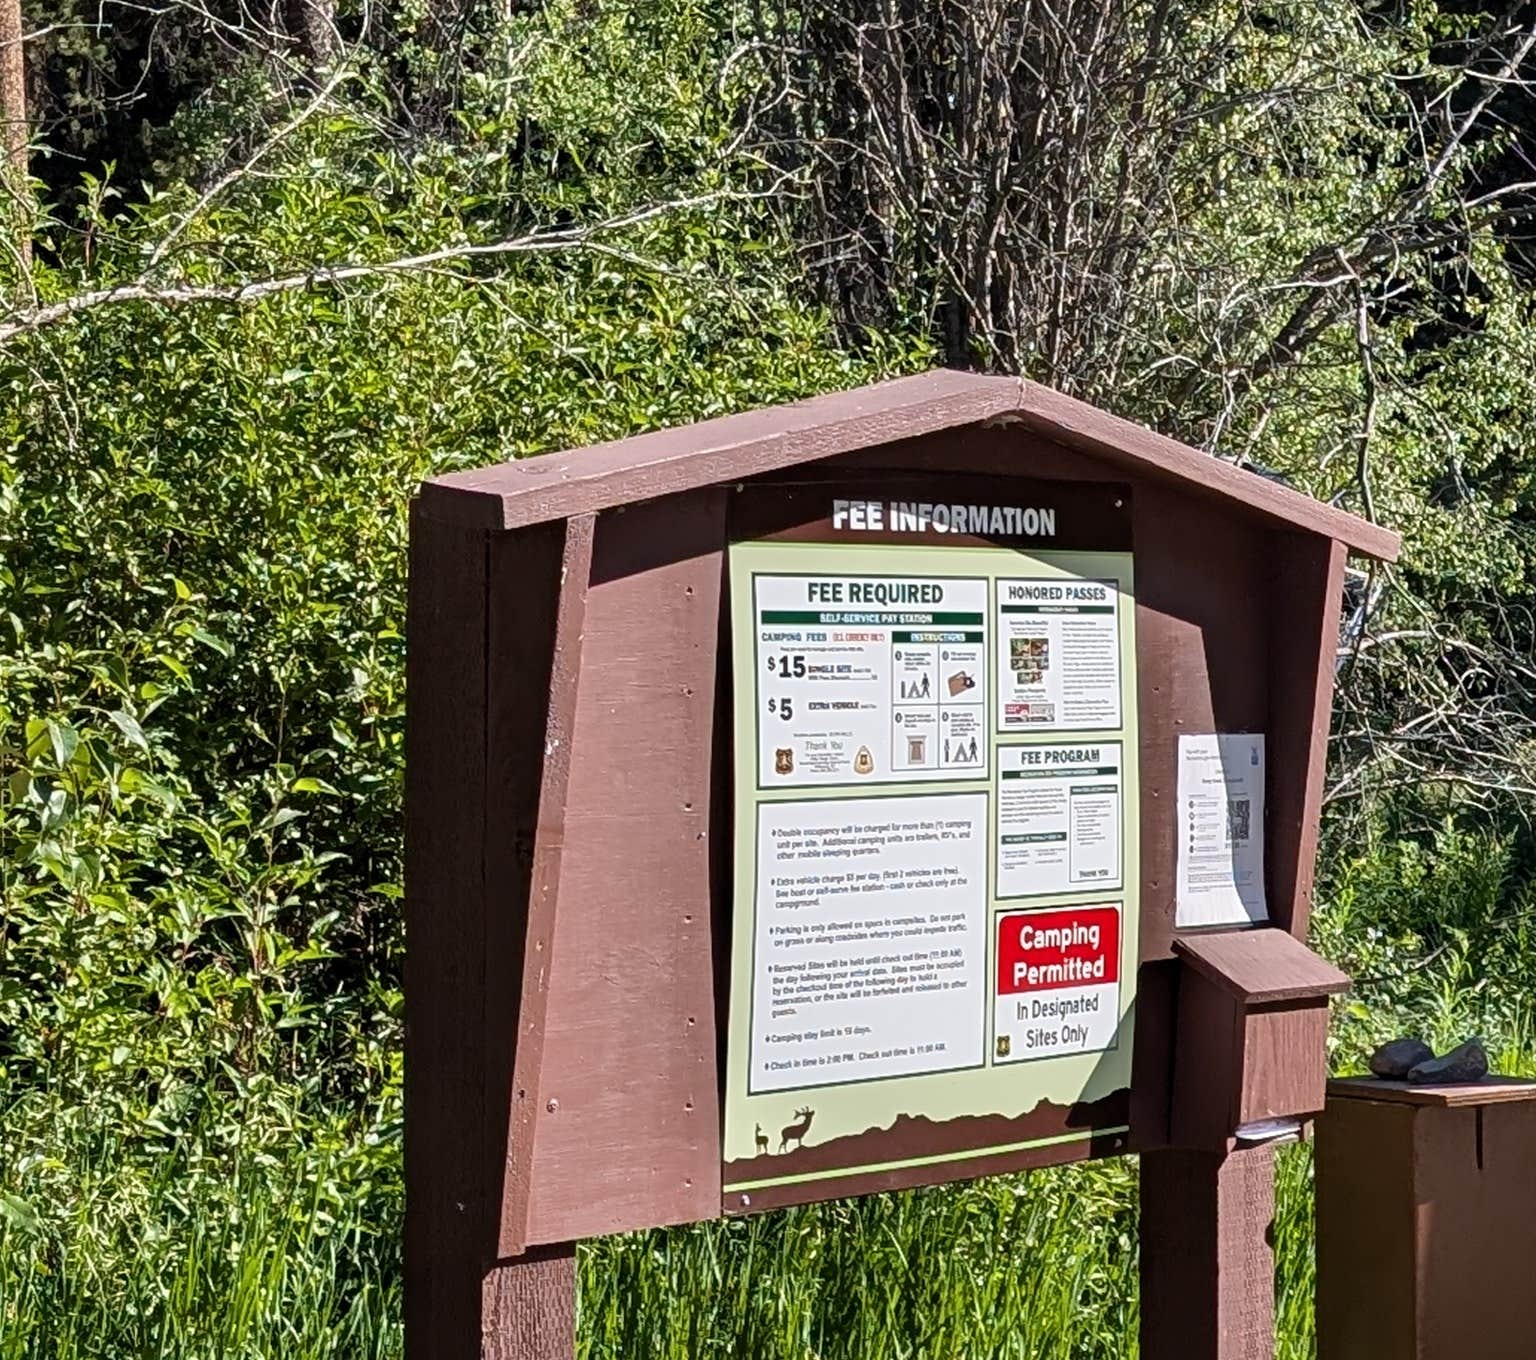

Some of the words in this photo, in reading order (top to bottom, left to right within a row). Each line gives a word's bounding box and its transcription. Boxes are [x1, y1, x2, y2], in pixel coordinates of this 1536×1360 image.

[833, 499, 883, 530] FEE
[890, 501, 1056, 536] INFORMATION
[808, 583, 842, 603] FEE
[850, 583, 943, 606] REQUIRED
[1009, 586, 1062, 600] HONORED
[1066, 587, 1106, 600] PASSES
[820, 614, 880, 623] SELF-SERVICE
[882, 614, 897, 623] PAY
[899, 615, 932, 623] STATION
[762, 632, 801, 641] CAMPING
[806, 632, 827, 642] FEES
[808, 665, 834, 673] SINGLE
[808, 702, 830, 710] EXTRA
[832, 702, 859, 710] VEHICLE
[1021, 751, 1041, 764] FEE
[1045, 749, 1100, 764] PROGRAM
[777, 827, 801, 837] Double
[803, 827, 840, 837] occupancy
[840, 825, 852, 833] will
[854, 825, 862, 833] be
[863, 823, 890, 834] charged
[891, 822, 901, 831] for
[919, 821, 934, 829] than
[944, 820, 971, 830] camping
[776, 851, 795, 859] other
[797, 849, 821, 858] mobile
[822, 848, 850, 858] sleeping
[851, 847, 881, 856] quarters.
[775, 889, 789, 898] See
[861, 883, 884, 892] station
[915, 879, 933, 888] check
[934, 878, 949, 888] only
[774, 924, 802, 937] Parking
[810, 923, 825, 934] only
[827, 921, 853, 930] allowed
[929, 914, 938, 923] Do
[951, 912, 965, 921] park
[814, 933, 834, 945] along
[869, 930, 889, 939] where
[890, 929, 903, 938] you
[903, 927, 922, 936] could
[948, 922, 968, 932] traffic.
[1020, 921, 1100, 953] Camping
[1013, 954, 1104, 986] Permitted
[1017, 1002, 1028, 1020] In
[1032, 994, 1099, 1021] Designated
[1026, 1028, 1058, 1048] Sites
[1061, 1025, 1089, 1047] Only
[770, 1059, 792, 1070] Check
[802, 1057, 817, 1067] time
[858, 1049, 879, 1060] Check
[881, 1049, 892, 1058] out
[893, 1047, 907, 1056] time
